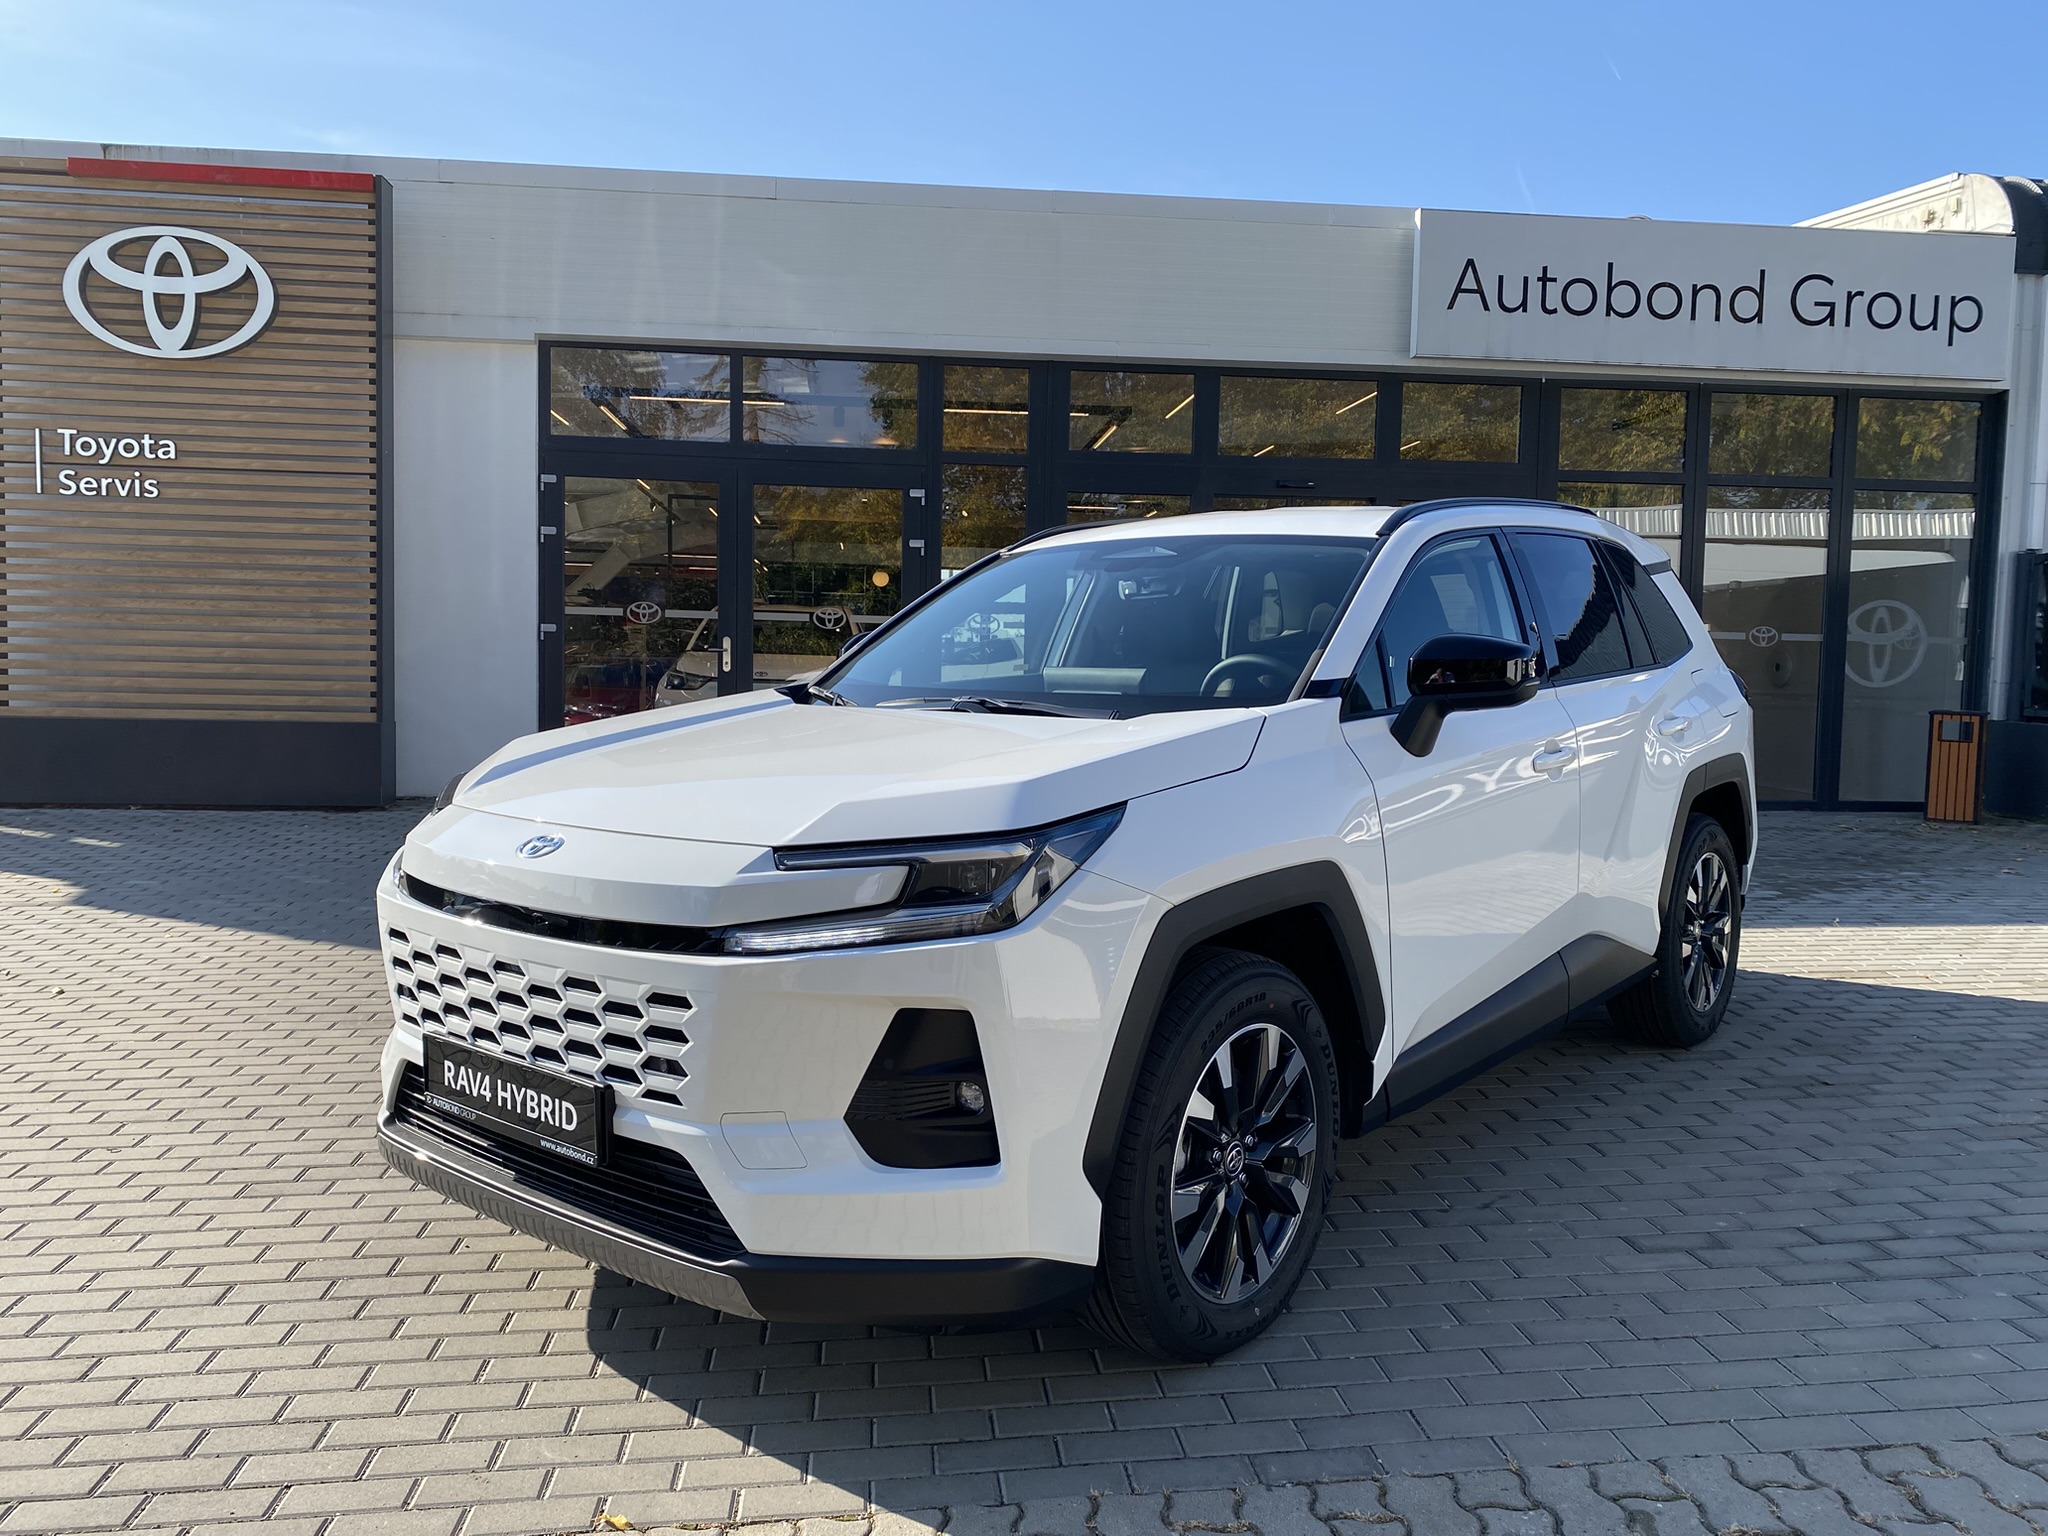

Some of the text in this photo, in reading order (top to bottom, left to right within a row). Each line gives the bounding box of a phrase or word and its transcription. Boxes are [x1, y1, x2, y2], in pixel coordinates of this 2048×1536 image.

[1446, 258, 1984, 347] Autobond Group
[57, 428, 177, 464] Toyota
[58, 469, 160, 498] Servis
[1200, 991, 1267, 1055] 235/60R18
[444, 1059, 579, 1132] RAV4 HYBRID
[540, 1139, 594, 1165] www.autobond.cz
[1155, 1164, 1181, 1302] DUNLOP
